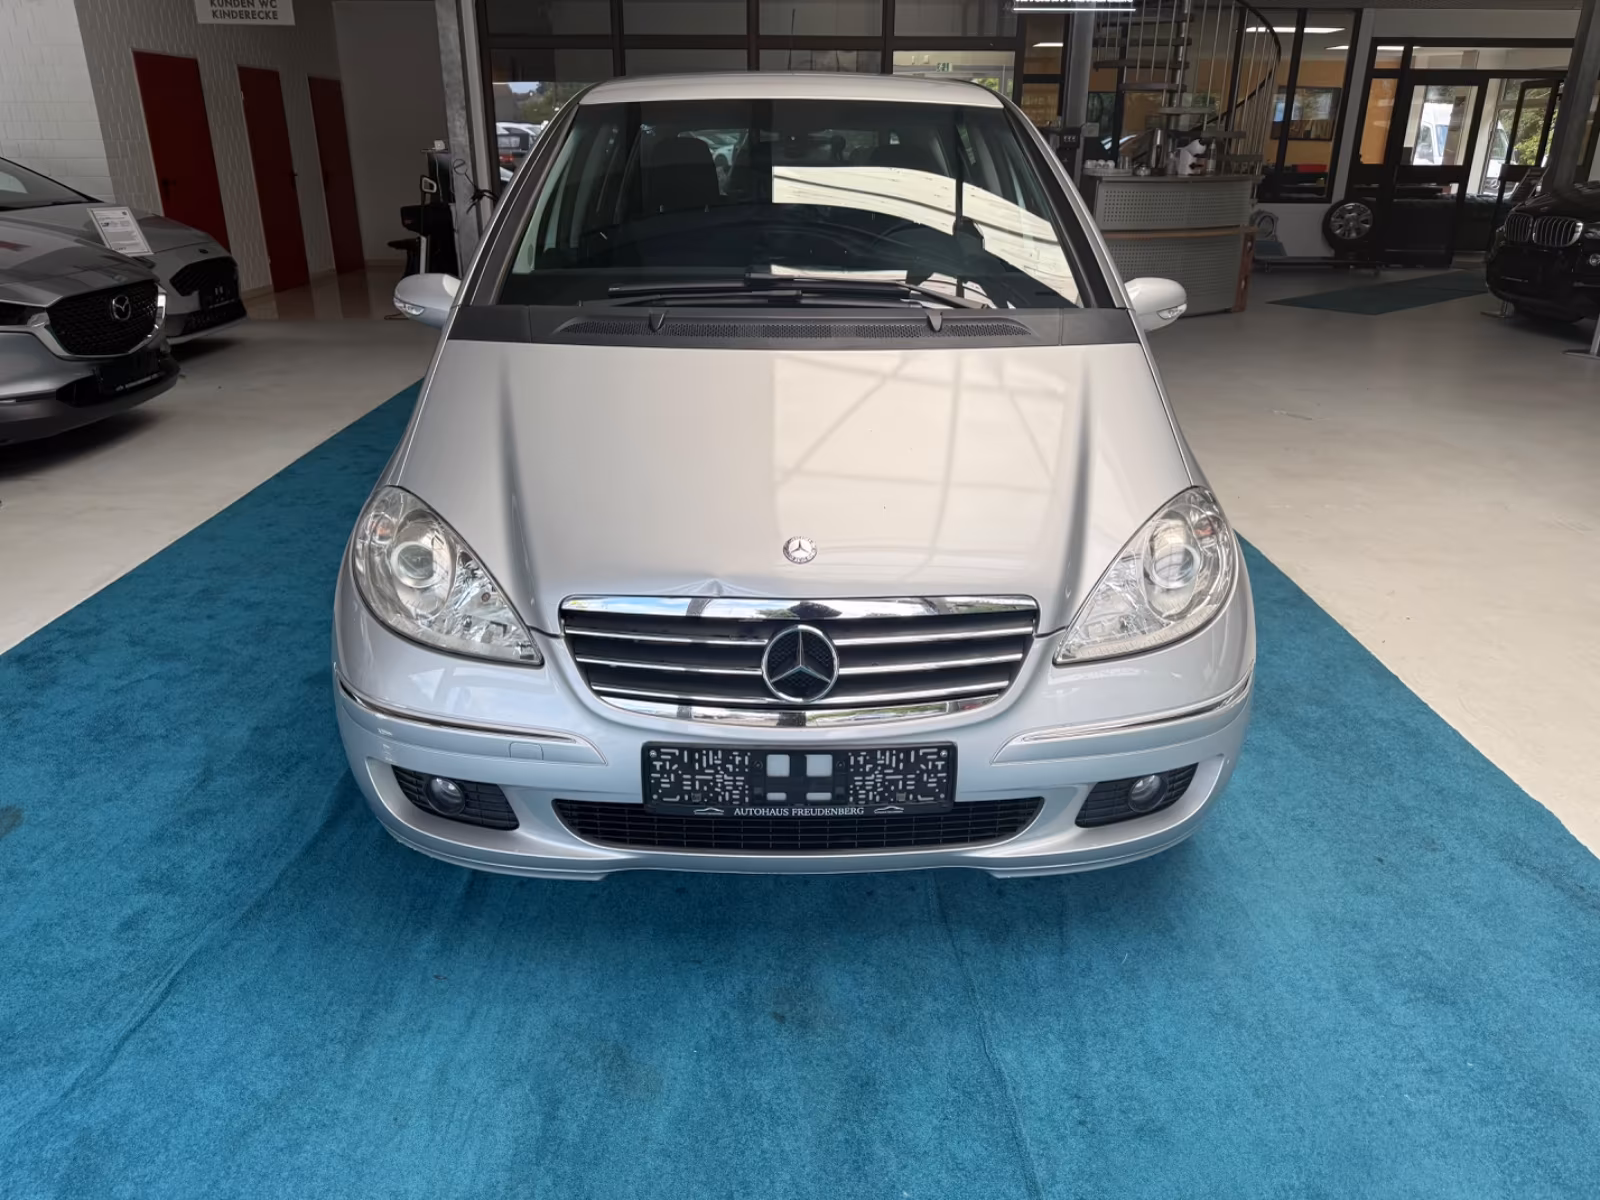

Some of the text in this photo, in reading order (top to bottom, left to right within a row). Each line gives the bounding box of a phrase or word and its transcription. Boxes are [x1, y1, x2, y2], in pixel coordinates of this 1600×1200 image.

[210, 0, 278, 8] KUNDEN WC
[212, 9, 279, 20] KINDERECKE
[733, 807, 865, 817] AUTOHAUS FREUDENBERG
